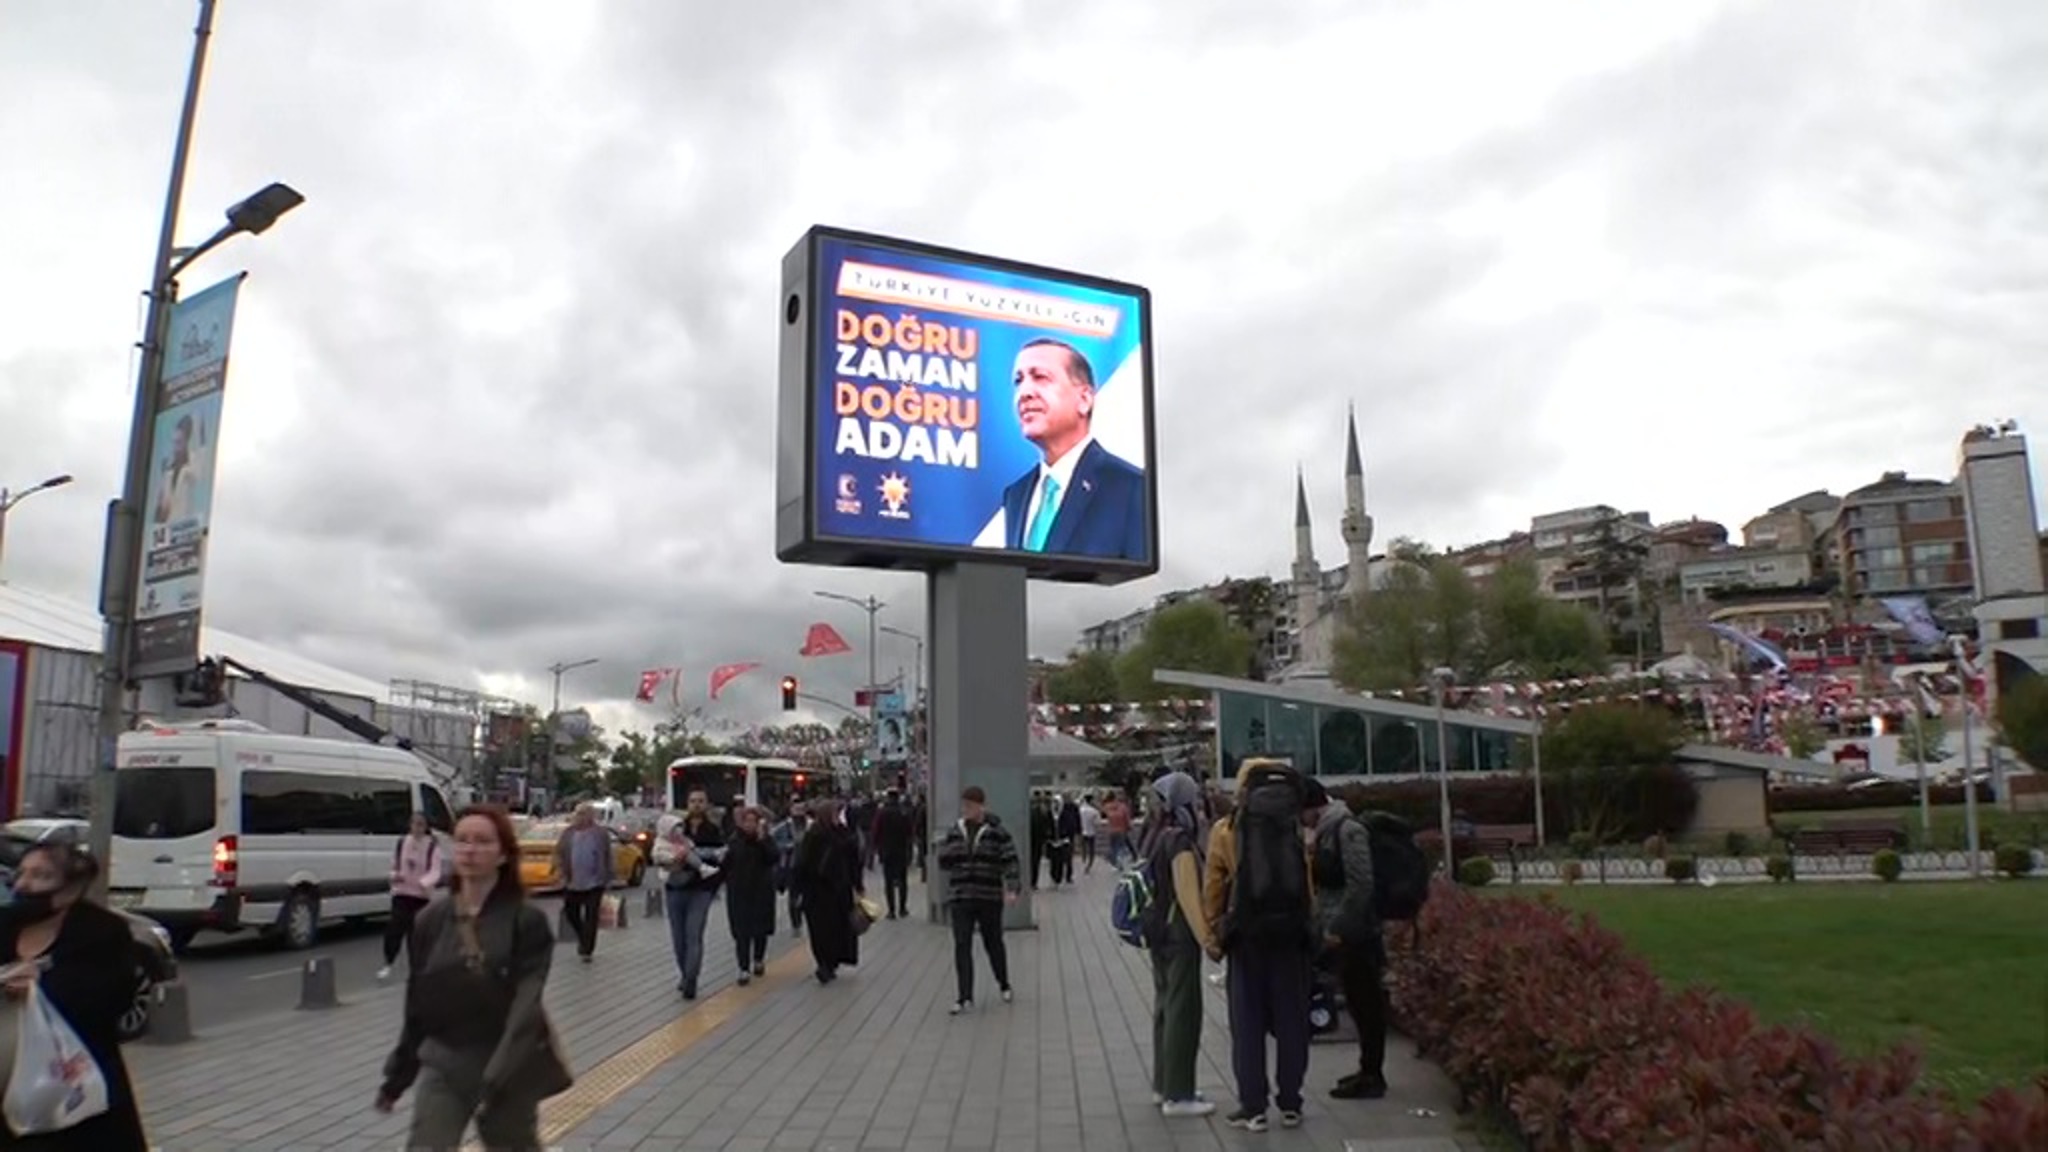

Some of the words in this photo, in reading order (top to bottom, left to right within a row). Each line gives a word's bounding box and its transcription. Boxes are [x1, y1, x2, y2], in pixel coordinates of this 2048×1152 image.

[837, 309, 979, 360] DOĞRU
[836, 342, 978, 393] ZAMAN
[836, 381, 979, 429] DOĞRU
[835, 417, 978, 469] ADAM
